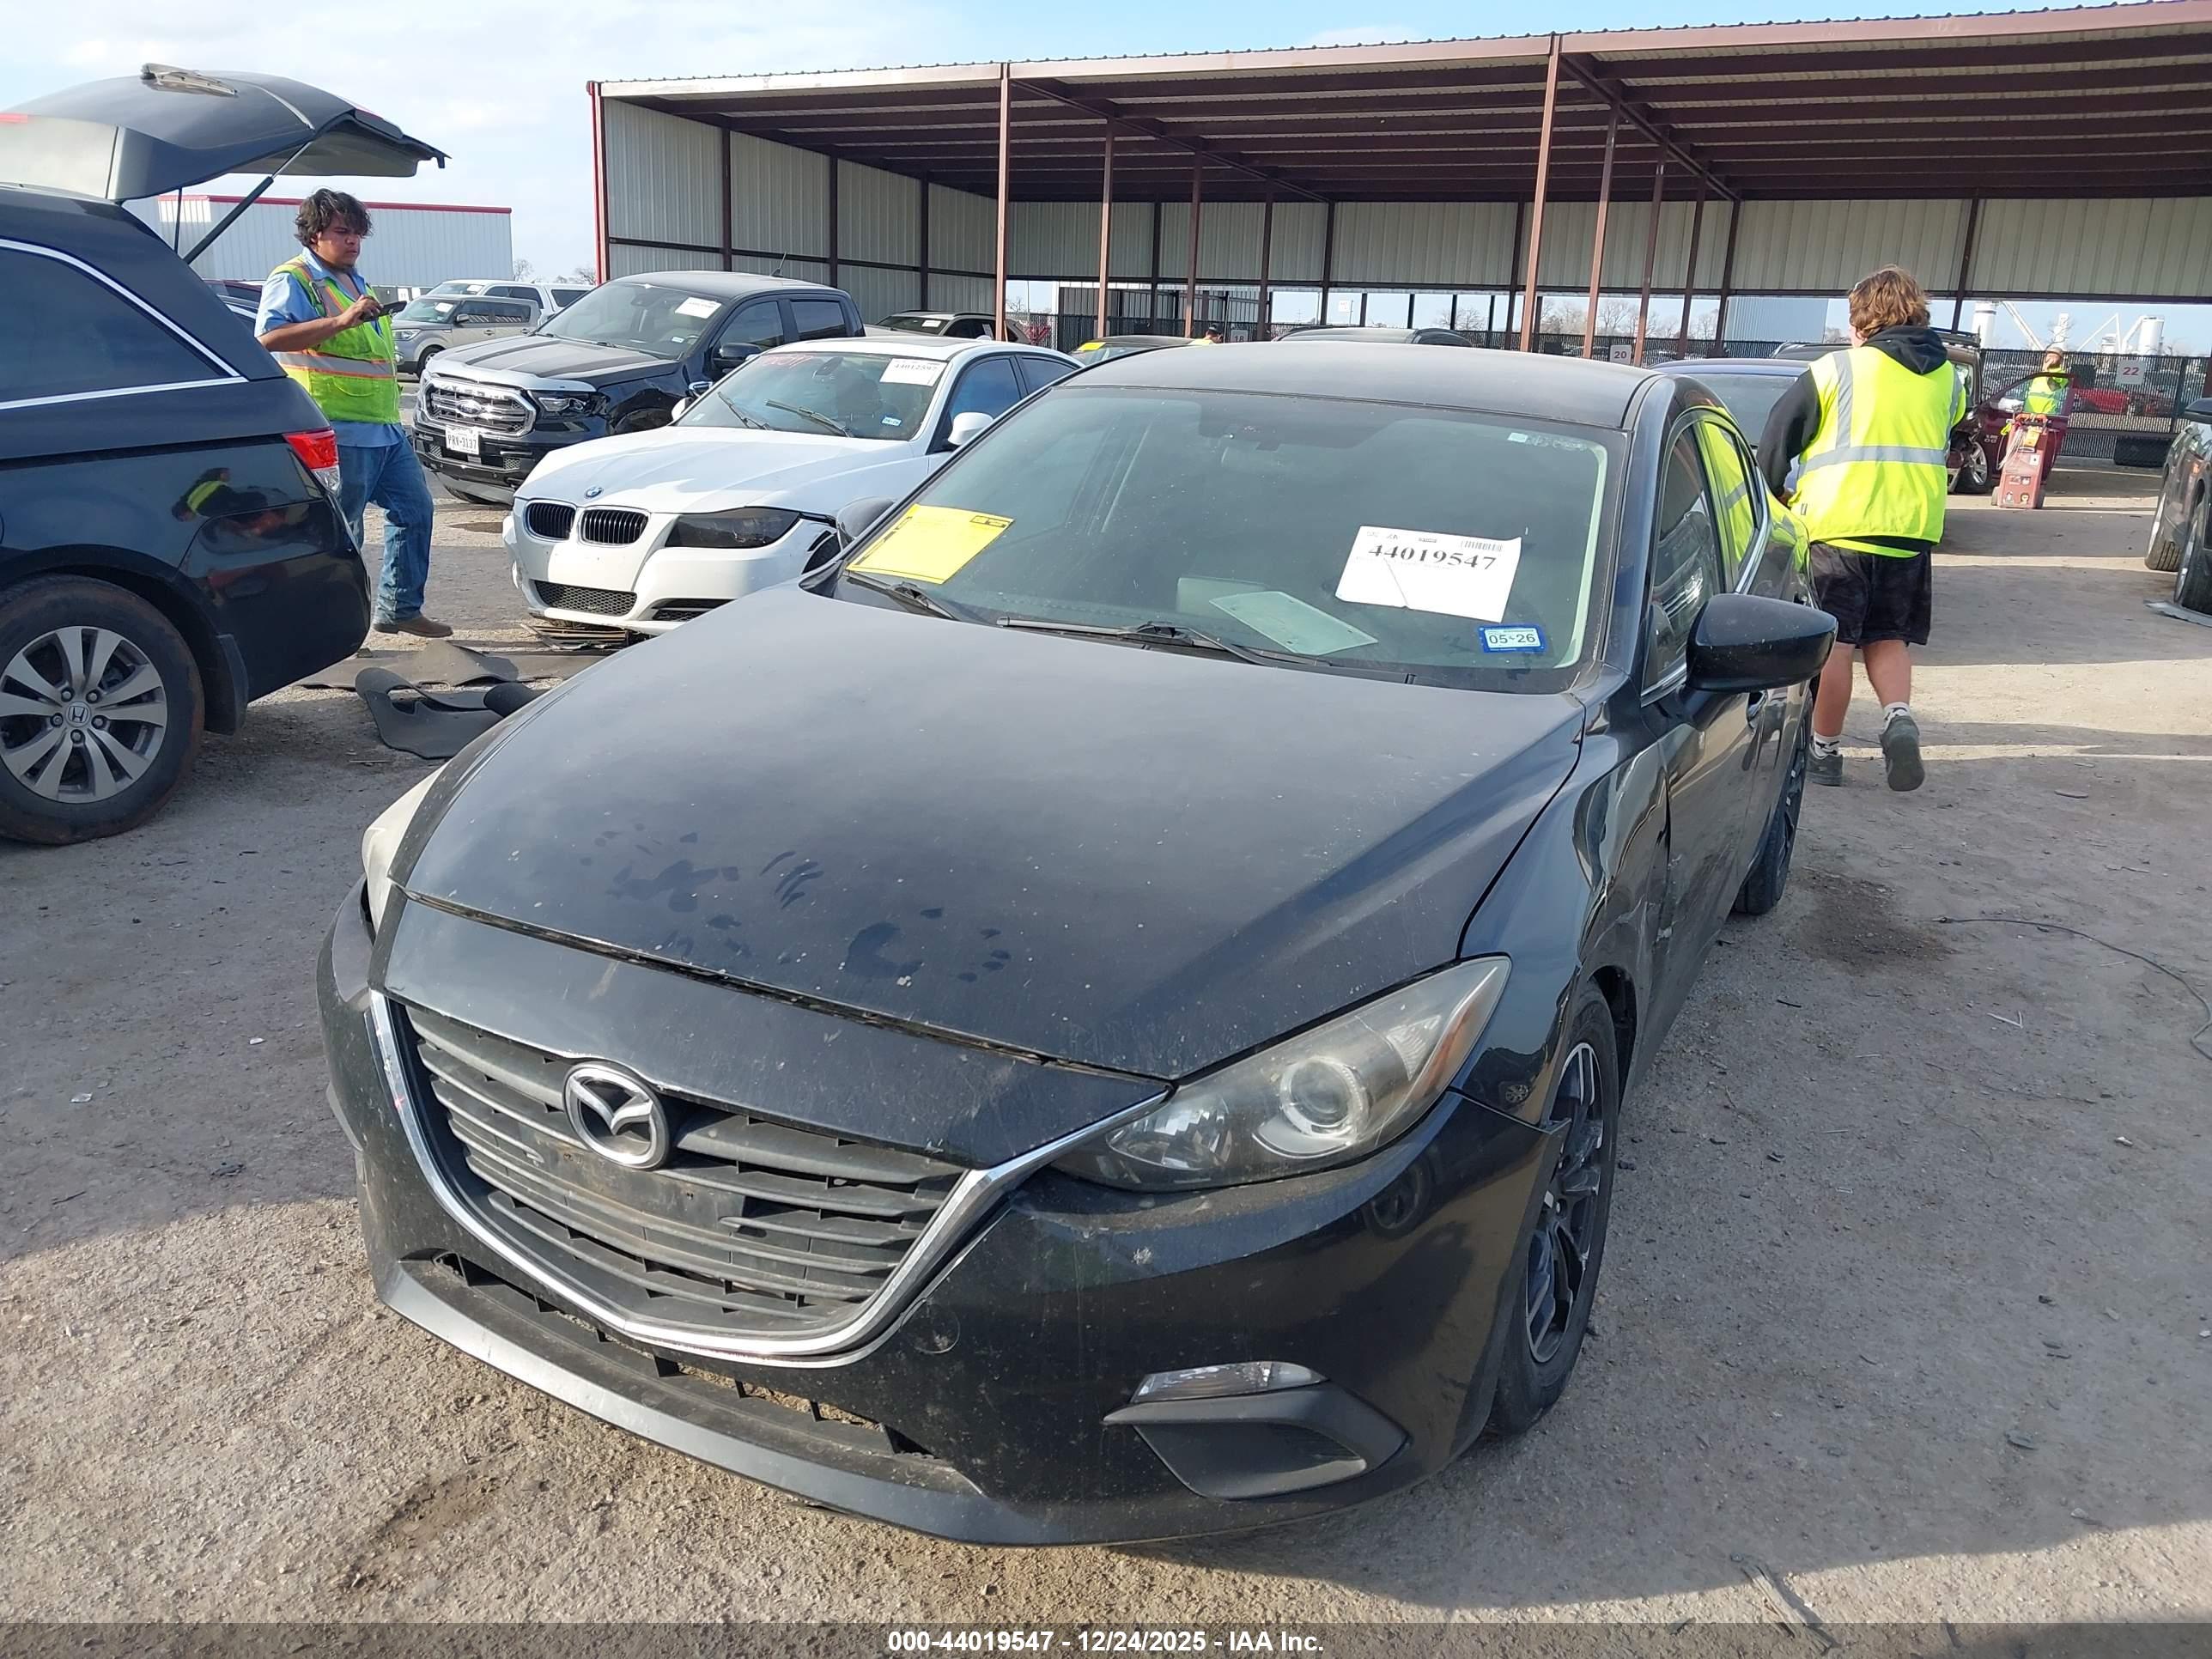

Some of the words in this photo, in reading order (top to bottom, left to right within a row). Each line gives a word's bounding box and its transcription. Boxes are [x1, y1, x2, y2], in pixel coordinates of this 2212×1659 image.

[1613, 350, 1627, 359] 20
[2122, 367, 2140, 375] 22
[1368, 544, 1498, 570] 44019547
